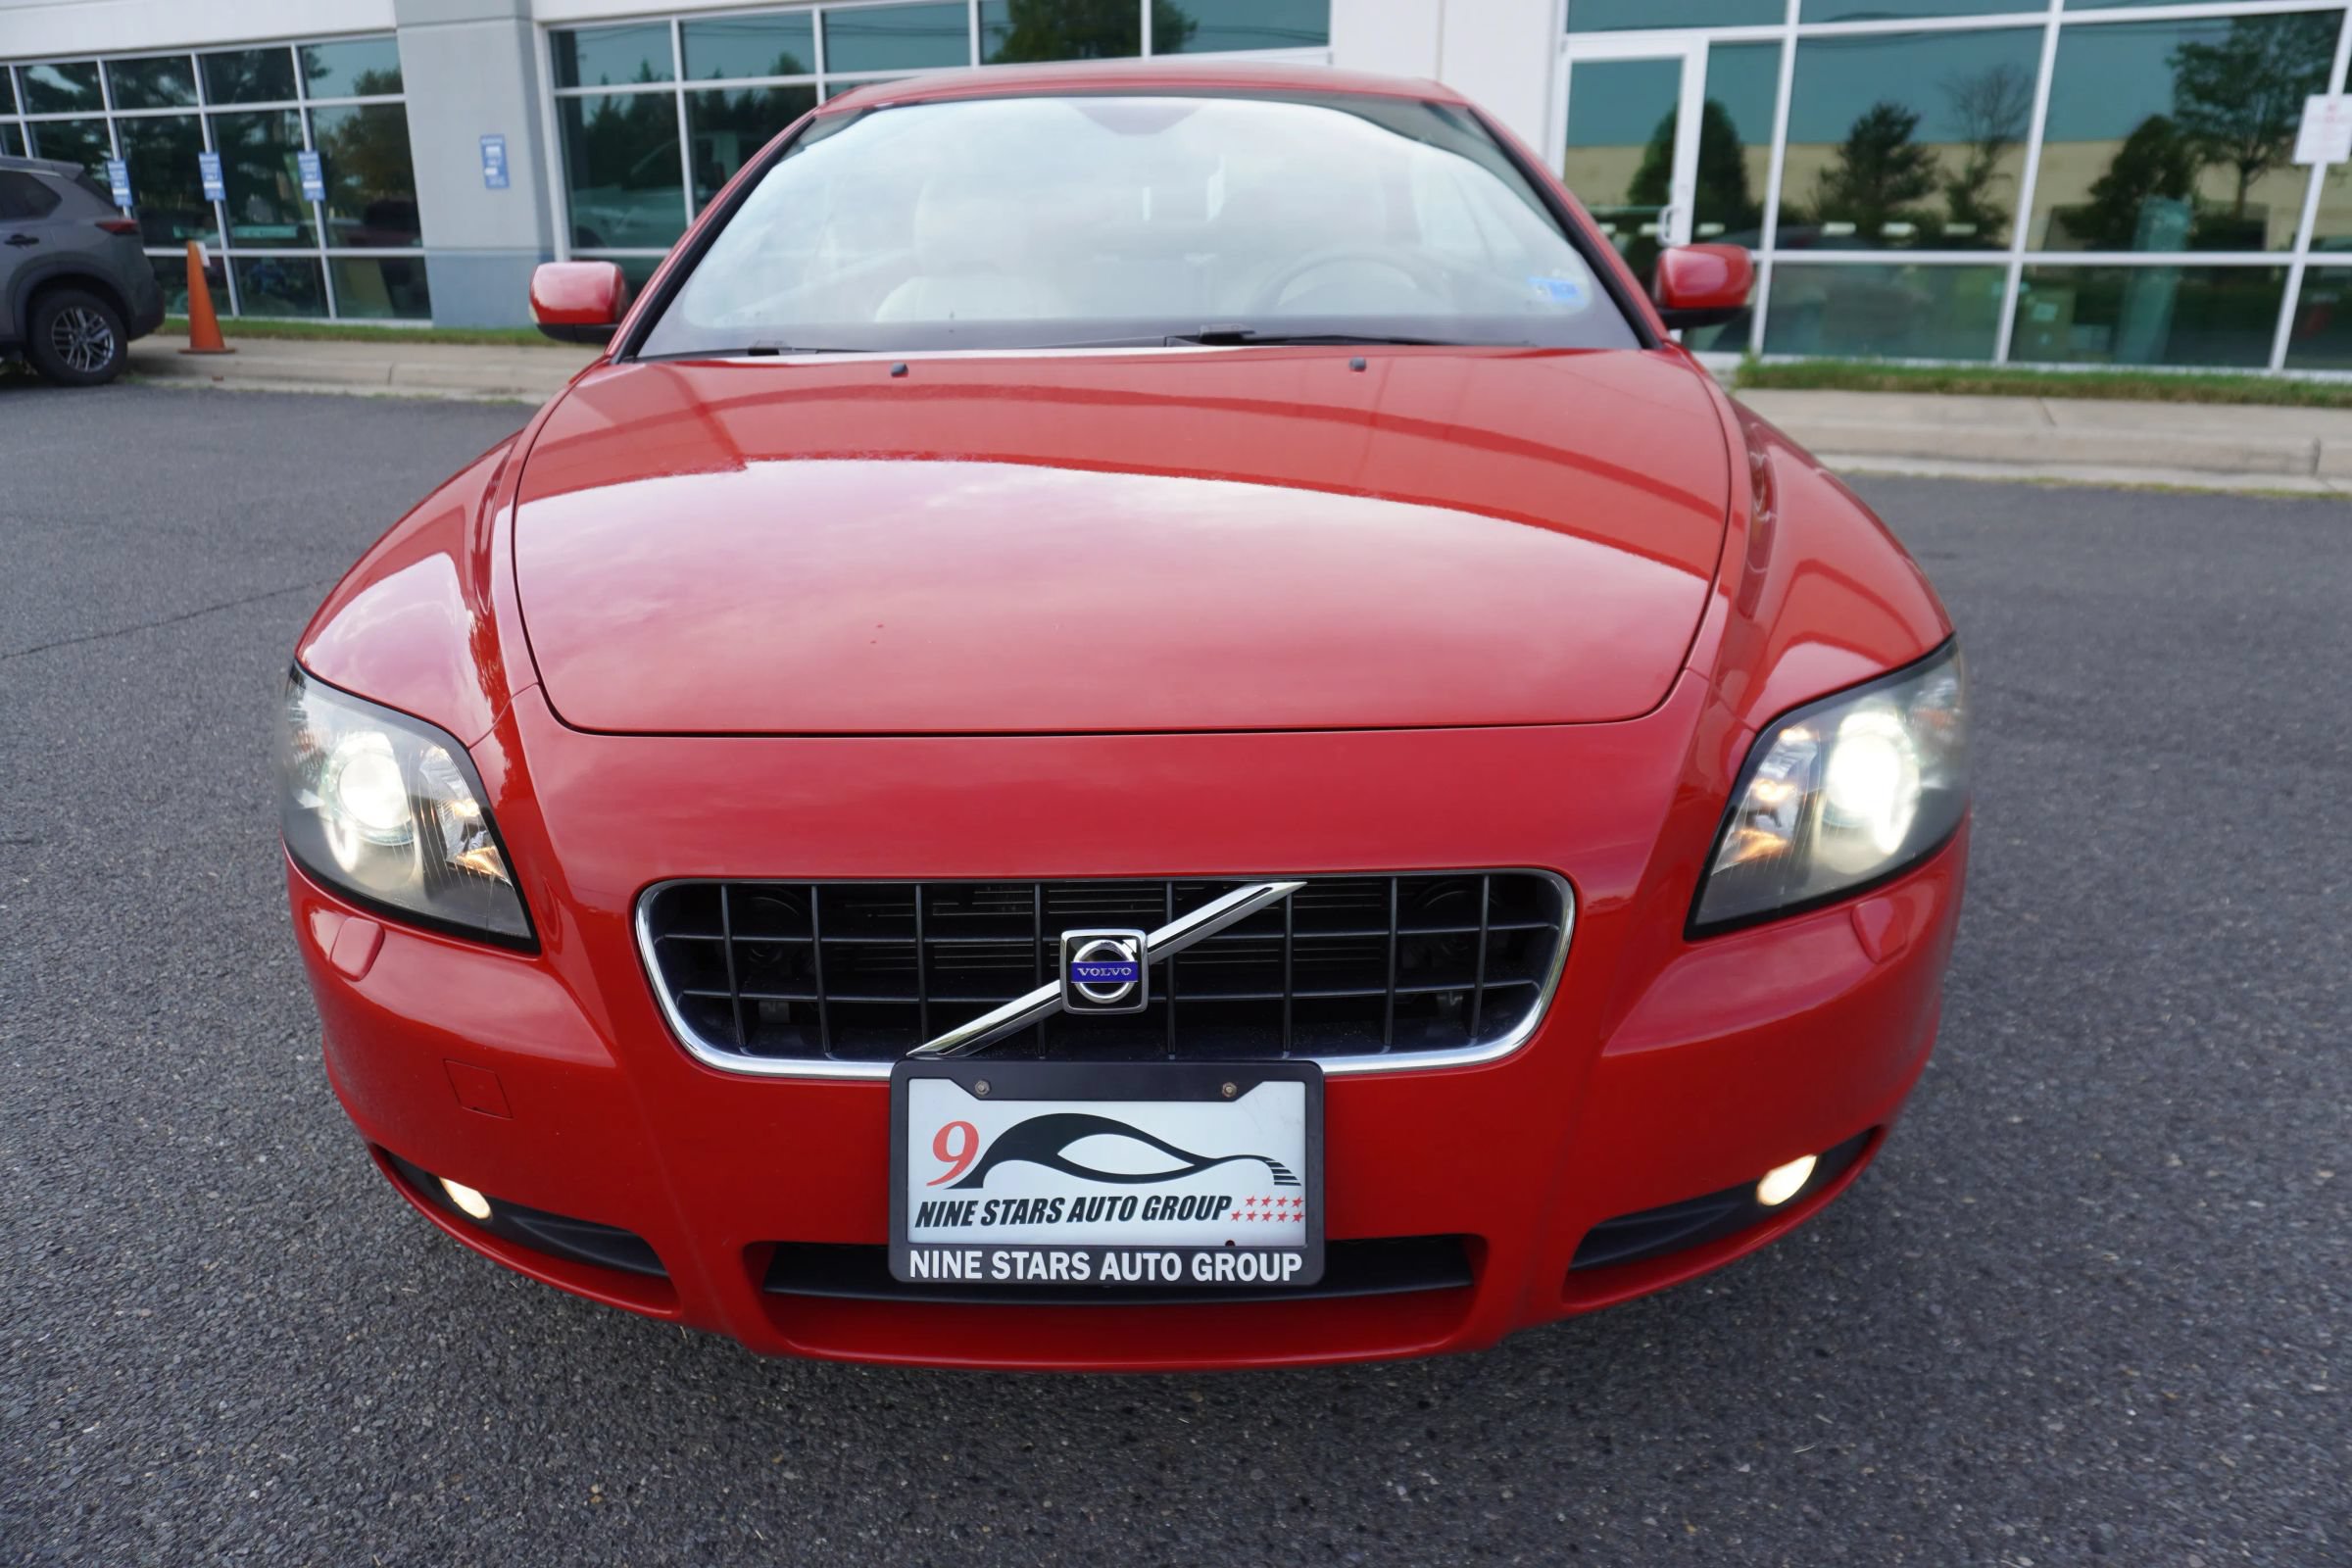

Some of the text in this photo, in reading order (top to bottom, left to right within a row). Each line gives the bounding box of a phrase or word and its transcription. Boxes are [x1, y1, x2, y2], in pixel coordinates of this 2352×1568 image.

[1077, 967, 1132, 976] VOLVO
[926, 1120, 980, 1187] 9
[915, 1195, 1233, 1228] NINE STARS AUTO GROUP
[909, 1250, 1302, 1282] NINE STARS AUTO GROUP
